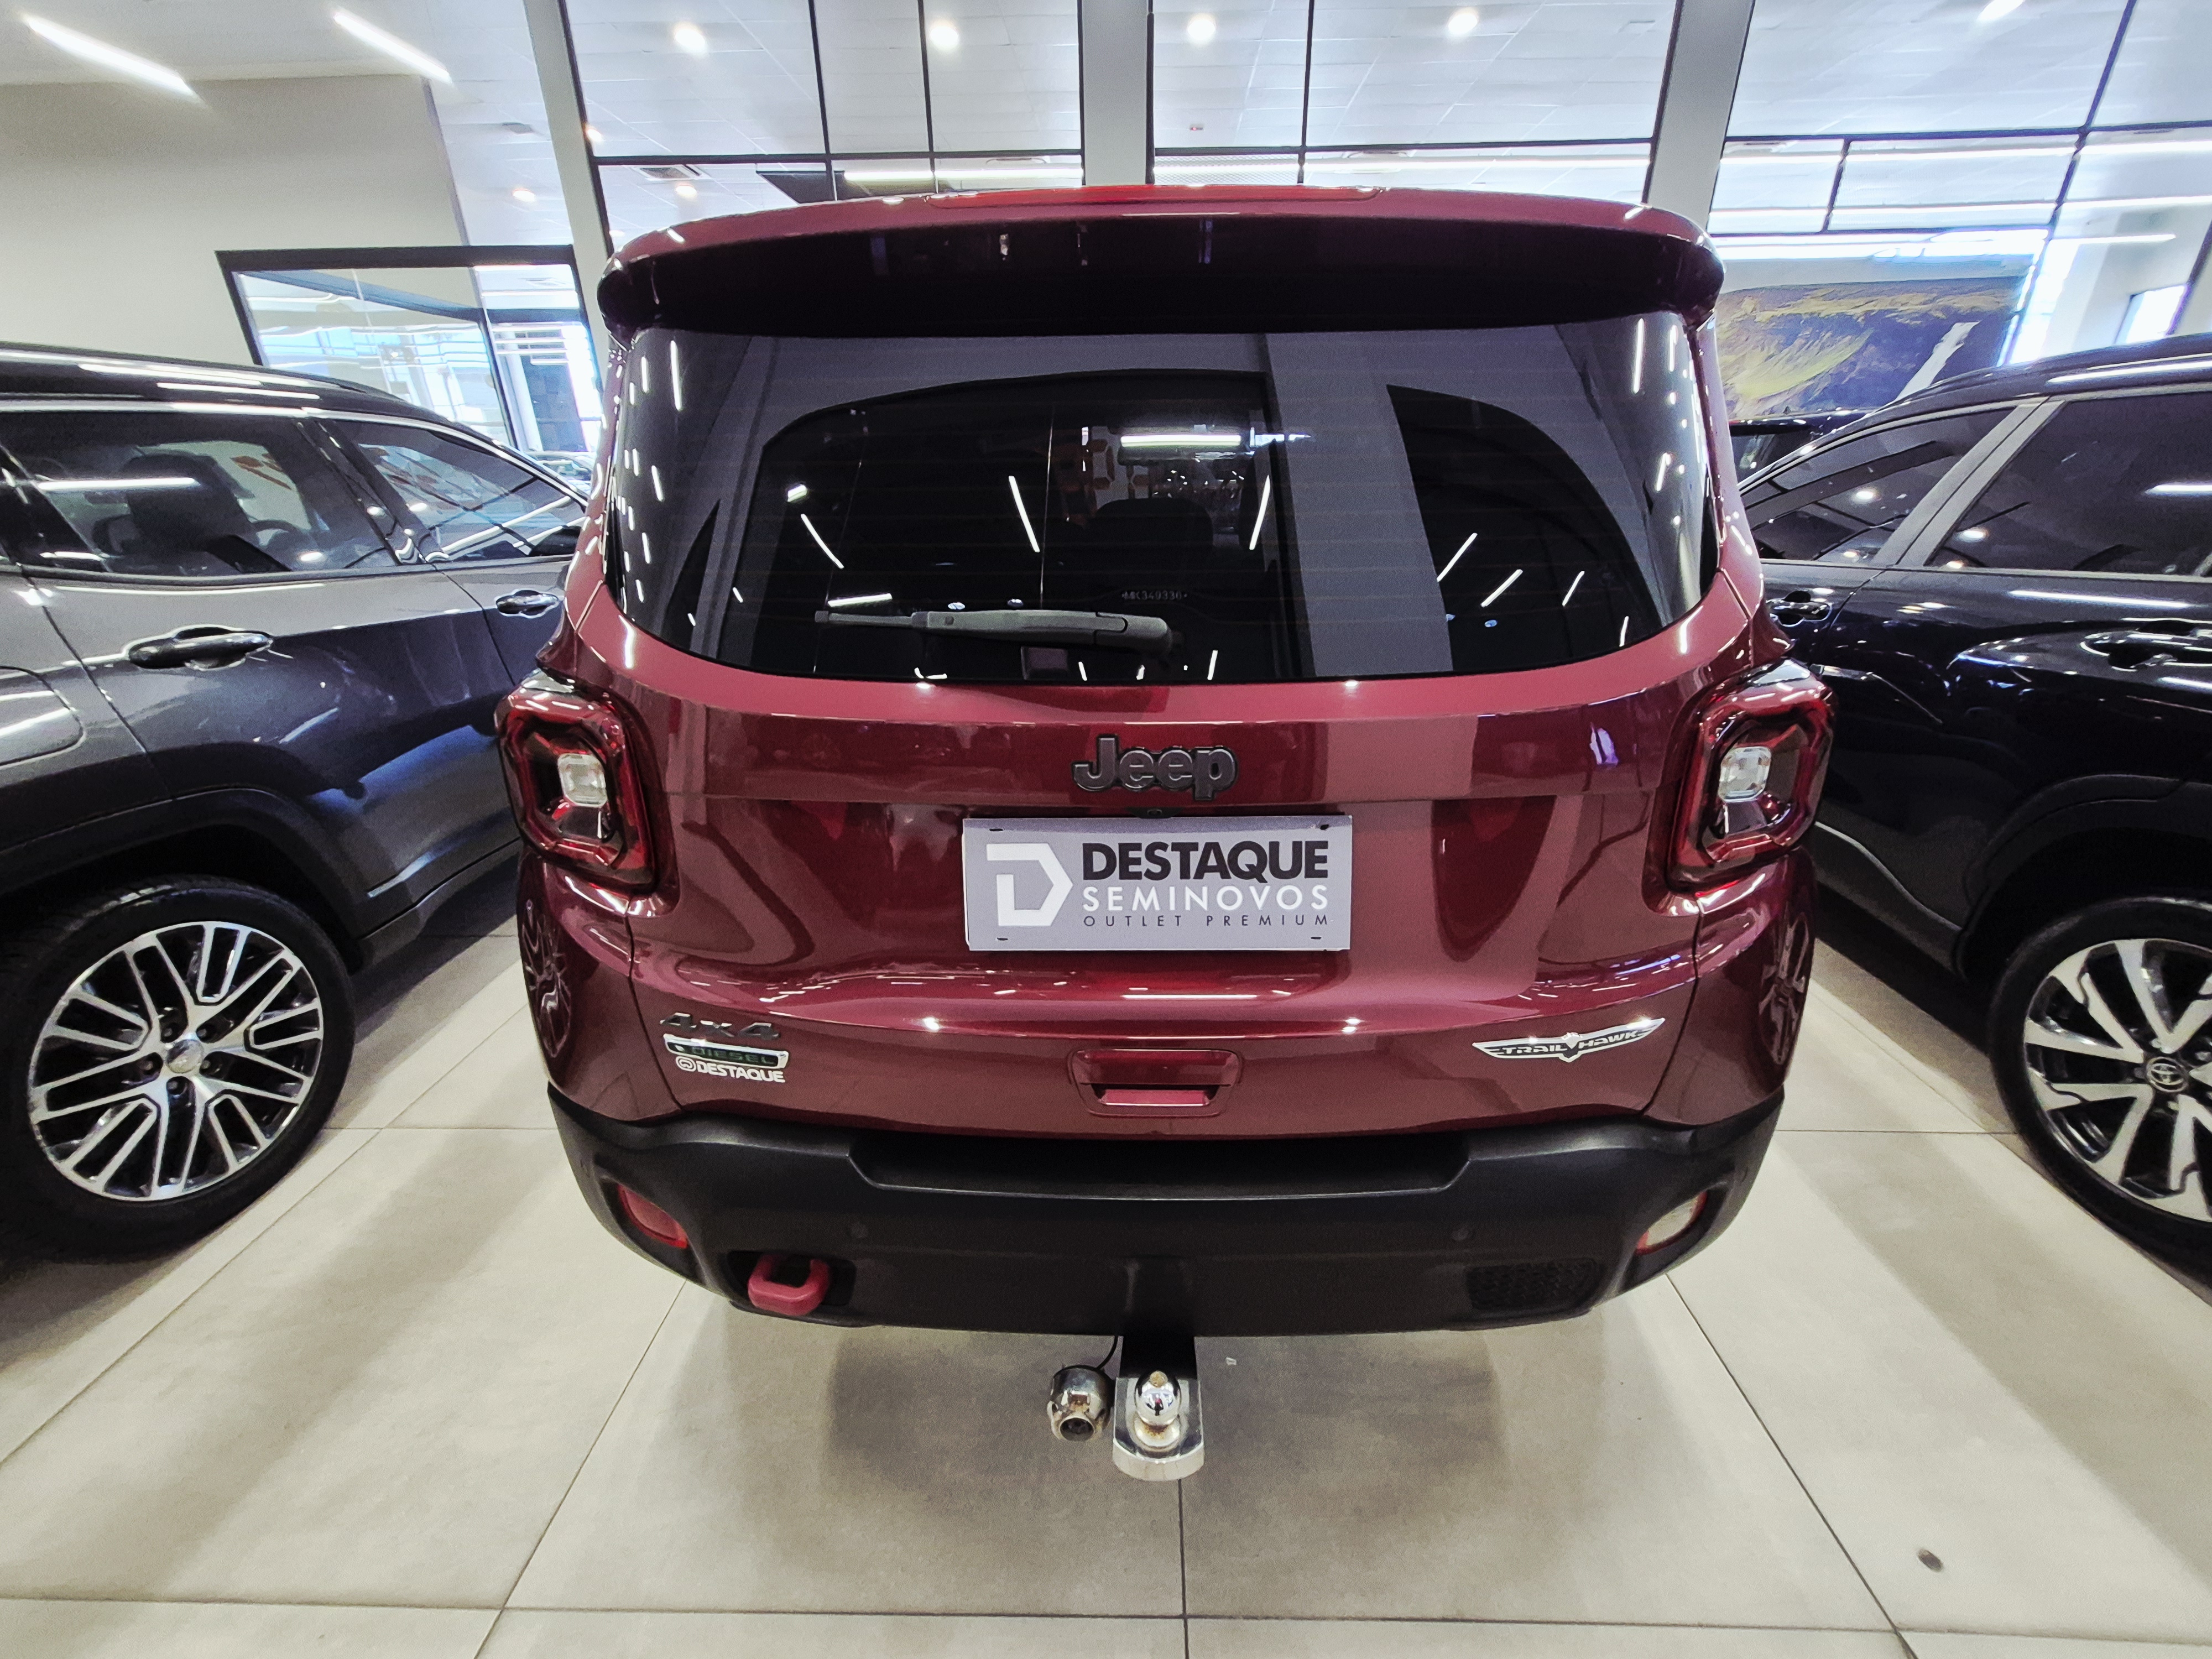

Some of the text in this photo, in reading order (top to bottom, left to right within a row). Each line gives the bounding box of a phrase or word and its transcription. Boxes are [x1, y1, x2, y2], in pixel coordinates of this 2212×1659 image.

[1072, 734, 1238, 800] Jeep
[1082, 841, 1329, 883] DESTAQUE
[1082, 885, 1328, 911] SEMINOVOS
[1083, 914, 1328, 927] OUTLET PREMIUM
[692, 1046, 775, 1065] DIESEL
[675, 1056, 786, 1083] @DESTAQUE
